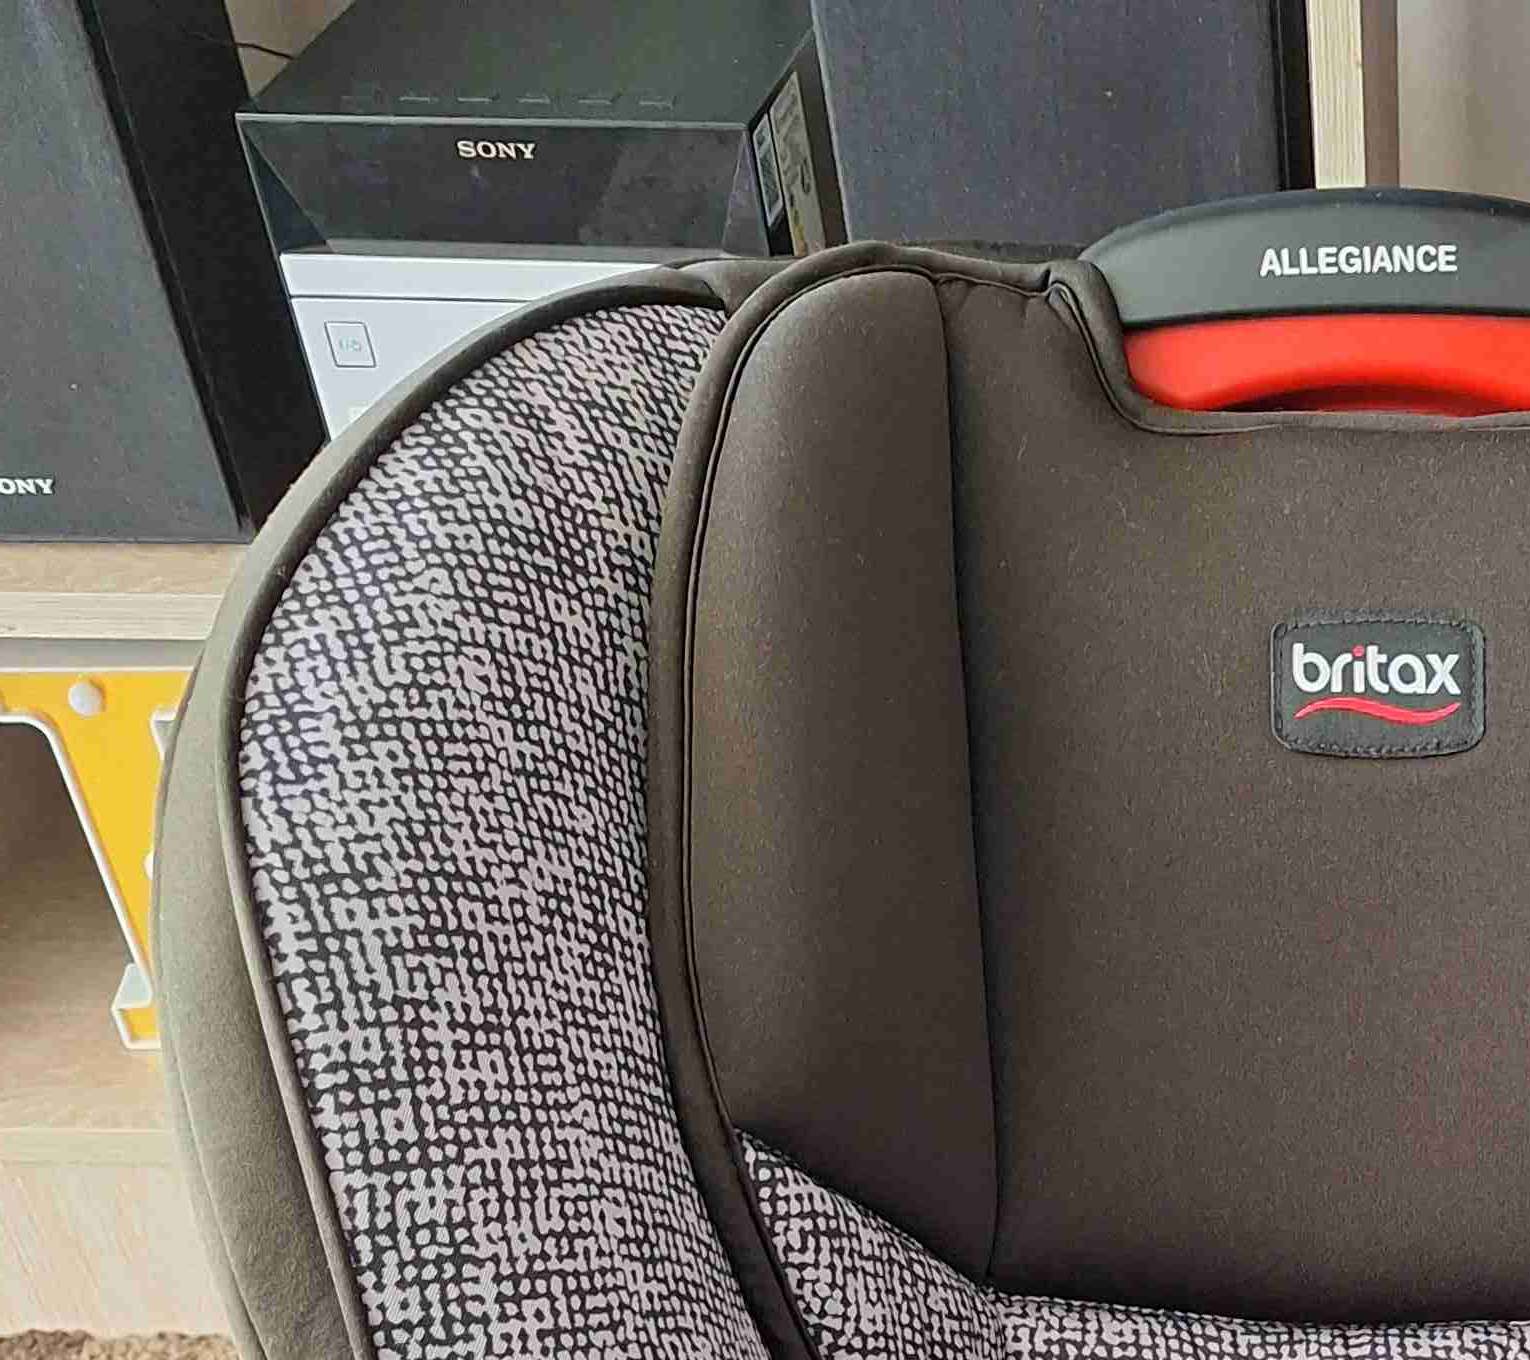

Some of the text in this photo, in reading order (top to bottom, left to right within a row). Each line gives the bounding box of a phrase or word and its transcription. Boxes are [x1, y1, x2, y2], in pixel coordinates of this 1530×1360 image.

[457, 140, 536, 159] SONY
[1259, 244, 1459, 277] ALLEGIANCE
[0, 478, 53, 496] ONY
[1292, 642, 1463, 697] britax
